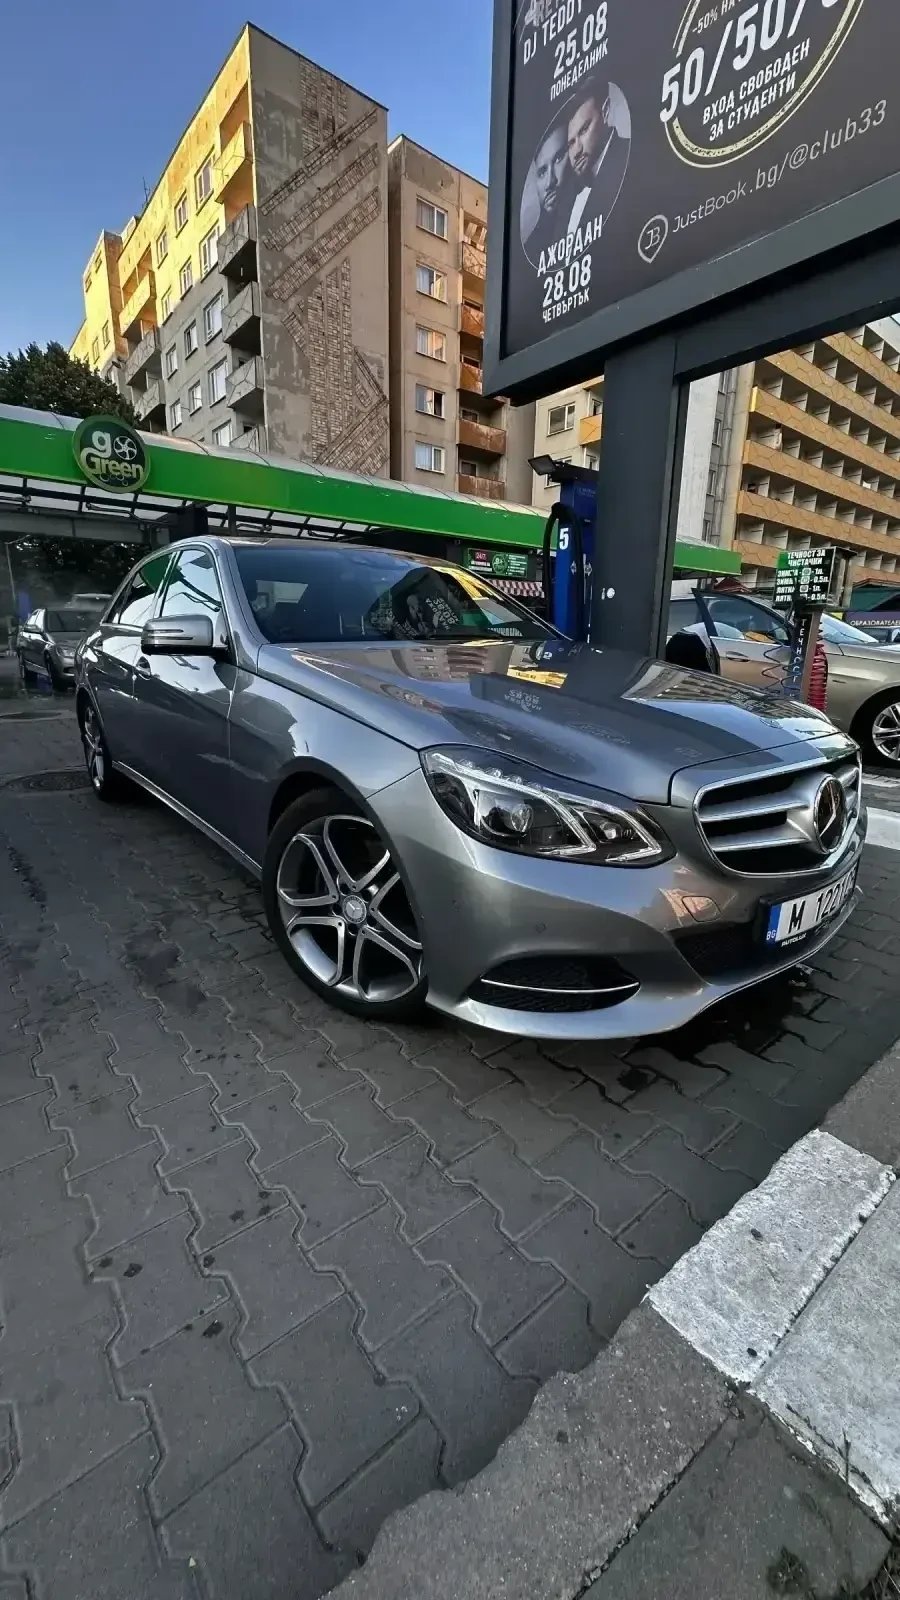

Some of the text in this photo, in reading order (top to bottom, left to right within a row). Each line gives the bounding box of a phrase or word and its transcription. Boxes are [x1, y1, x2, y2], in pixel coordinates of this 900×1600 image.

[523, 32, 537, 65] DJ
[550, 37, 609, 101] ПОНЕДЕЛНИК
[553, 1, 608, 79] 25.08
[659, 0, 838, 123] 50/50/
[702, 37, 811, 125] ВХОД СВОБОДЕН
[709, 71, 797, 142] ЗА СТУДЕНТИ
[672, 99, 887, 233] JustBook.bg/@club33
[537, 213, 603, 278] ДЖОРДАН
[542, 253, 592, 308] 28.08
[542, 287, 590, 323] ЧЕТВЪРТЪК
[80, 447, 144, 478] Green
[559, 527, 569, 550] 5
[766, 929, 777, 941] BG
[787, 900, 806, 934] M
